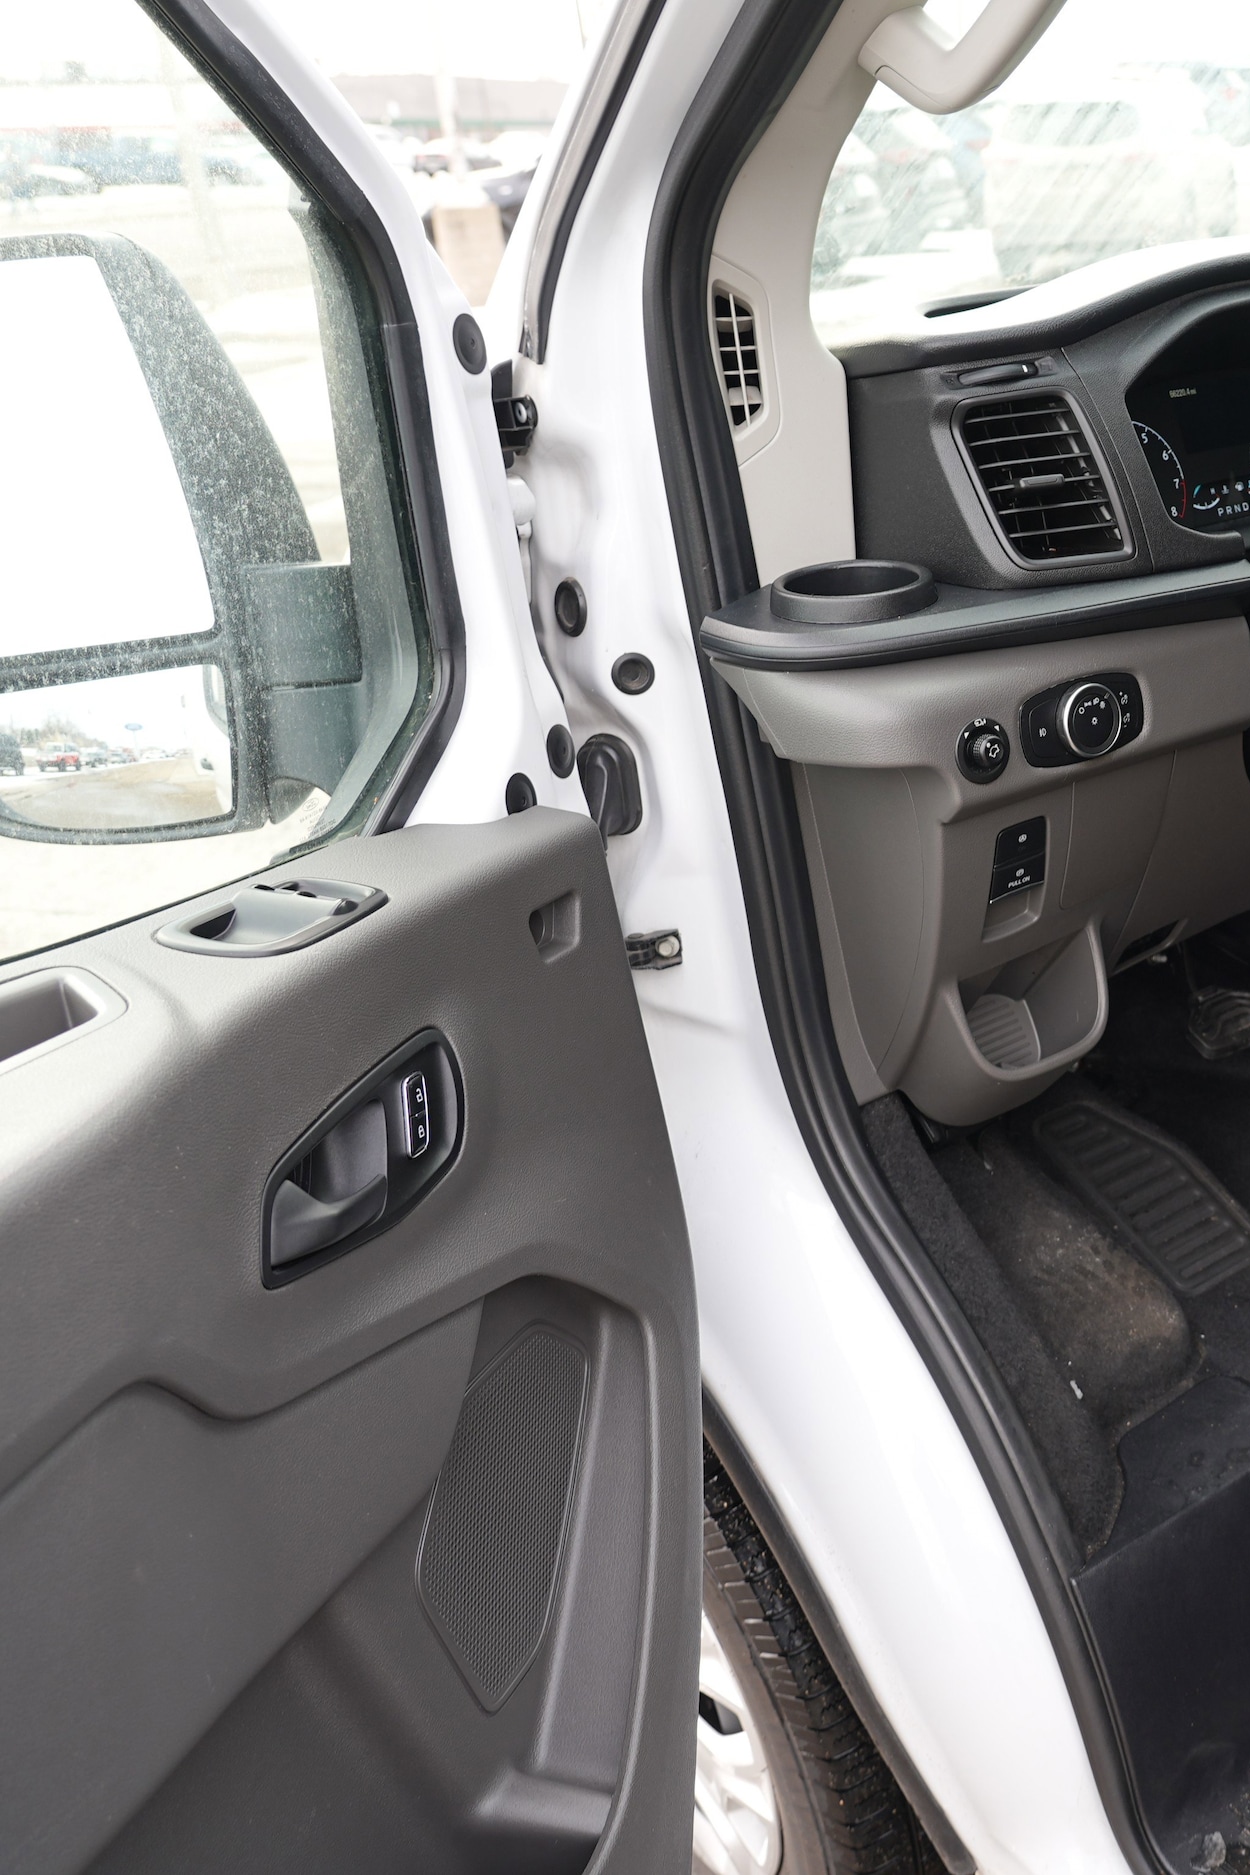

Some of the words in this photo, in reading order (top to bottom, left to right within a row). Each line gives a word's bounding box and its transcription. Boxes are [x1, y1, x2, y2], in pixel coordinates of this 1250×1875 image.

[1141, 433, 1148, 444] 5
[1162, 450, 1169, 461] 6
[1173, 479, 1180, 489] 7
[1170, 506, 1178, 517] 8
[1008, 879, 1021, 888] PULL
[1022, 875, 1030, 883] ON
